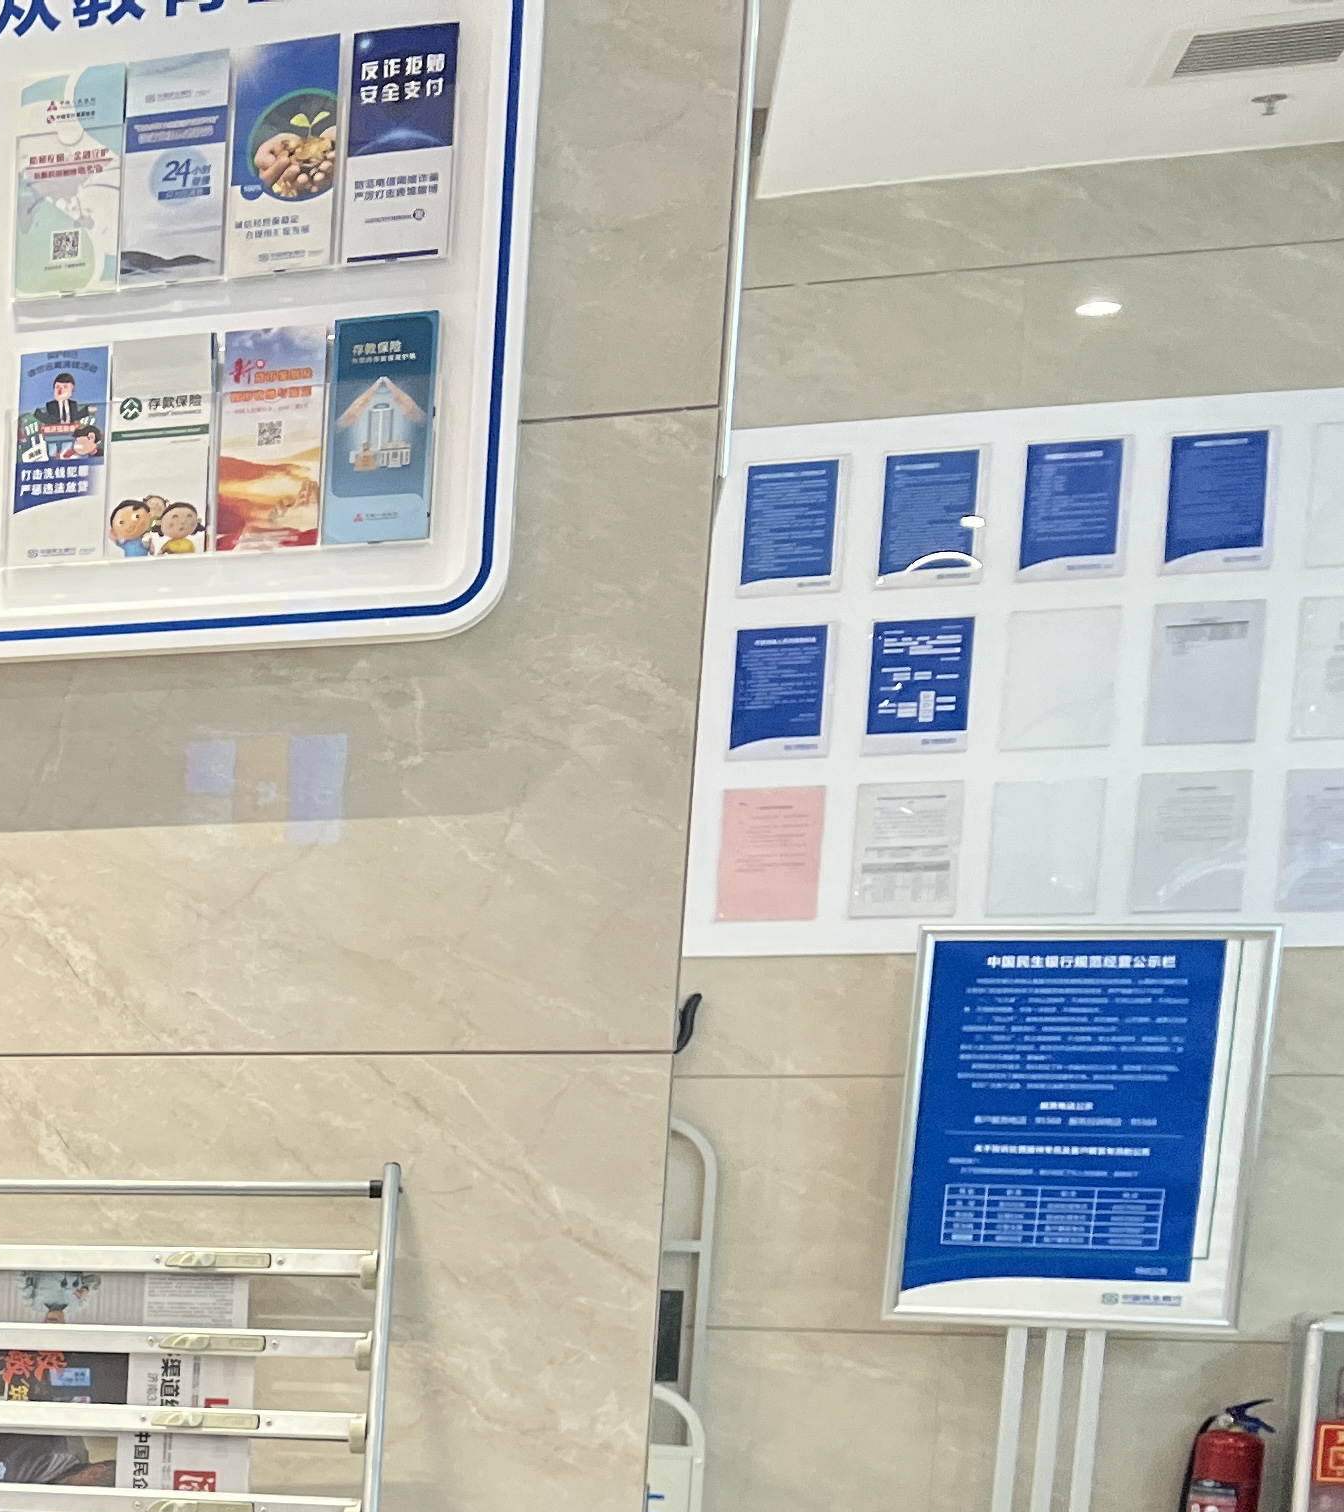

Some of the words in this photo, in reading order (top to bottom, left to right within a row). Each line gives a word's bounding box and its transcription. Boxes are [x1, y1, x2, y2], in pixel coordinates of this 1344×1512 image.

[360, 78, 444, 105] 安全支付
[162, 158, 192, 188] 24
[147, 394, 202, 411] 存款保险
[160, 1353, 182, 1407] 渠道
